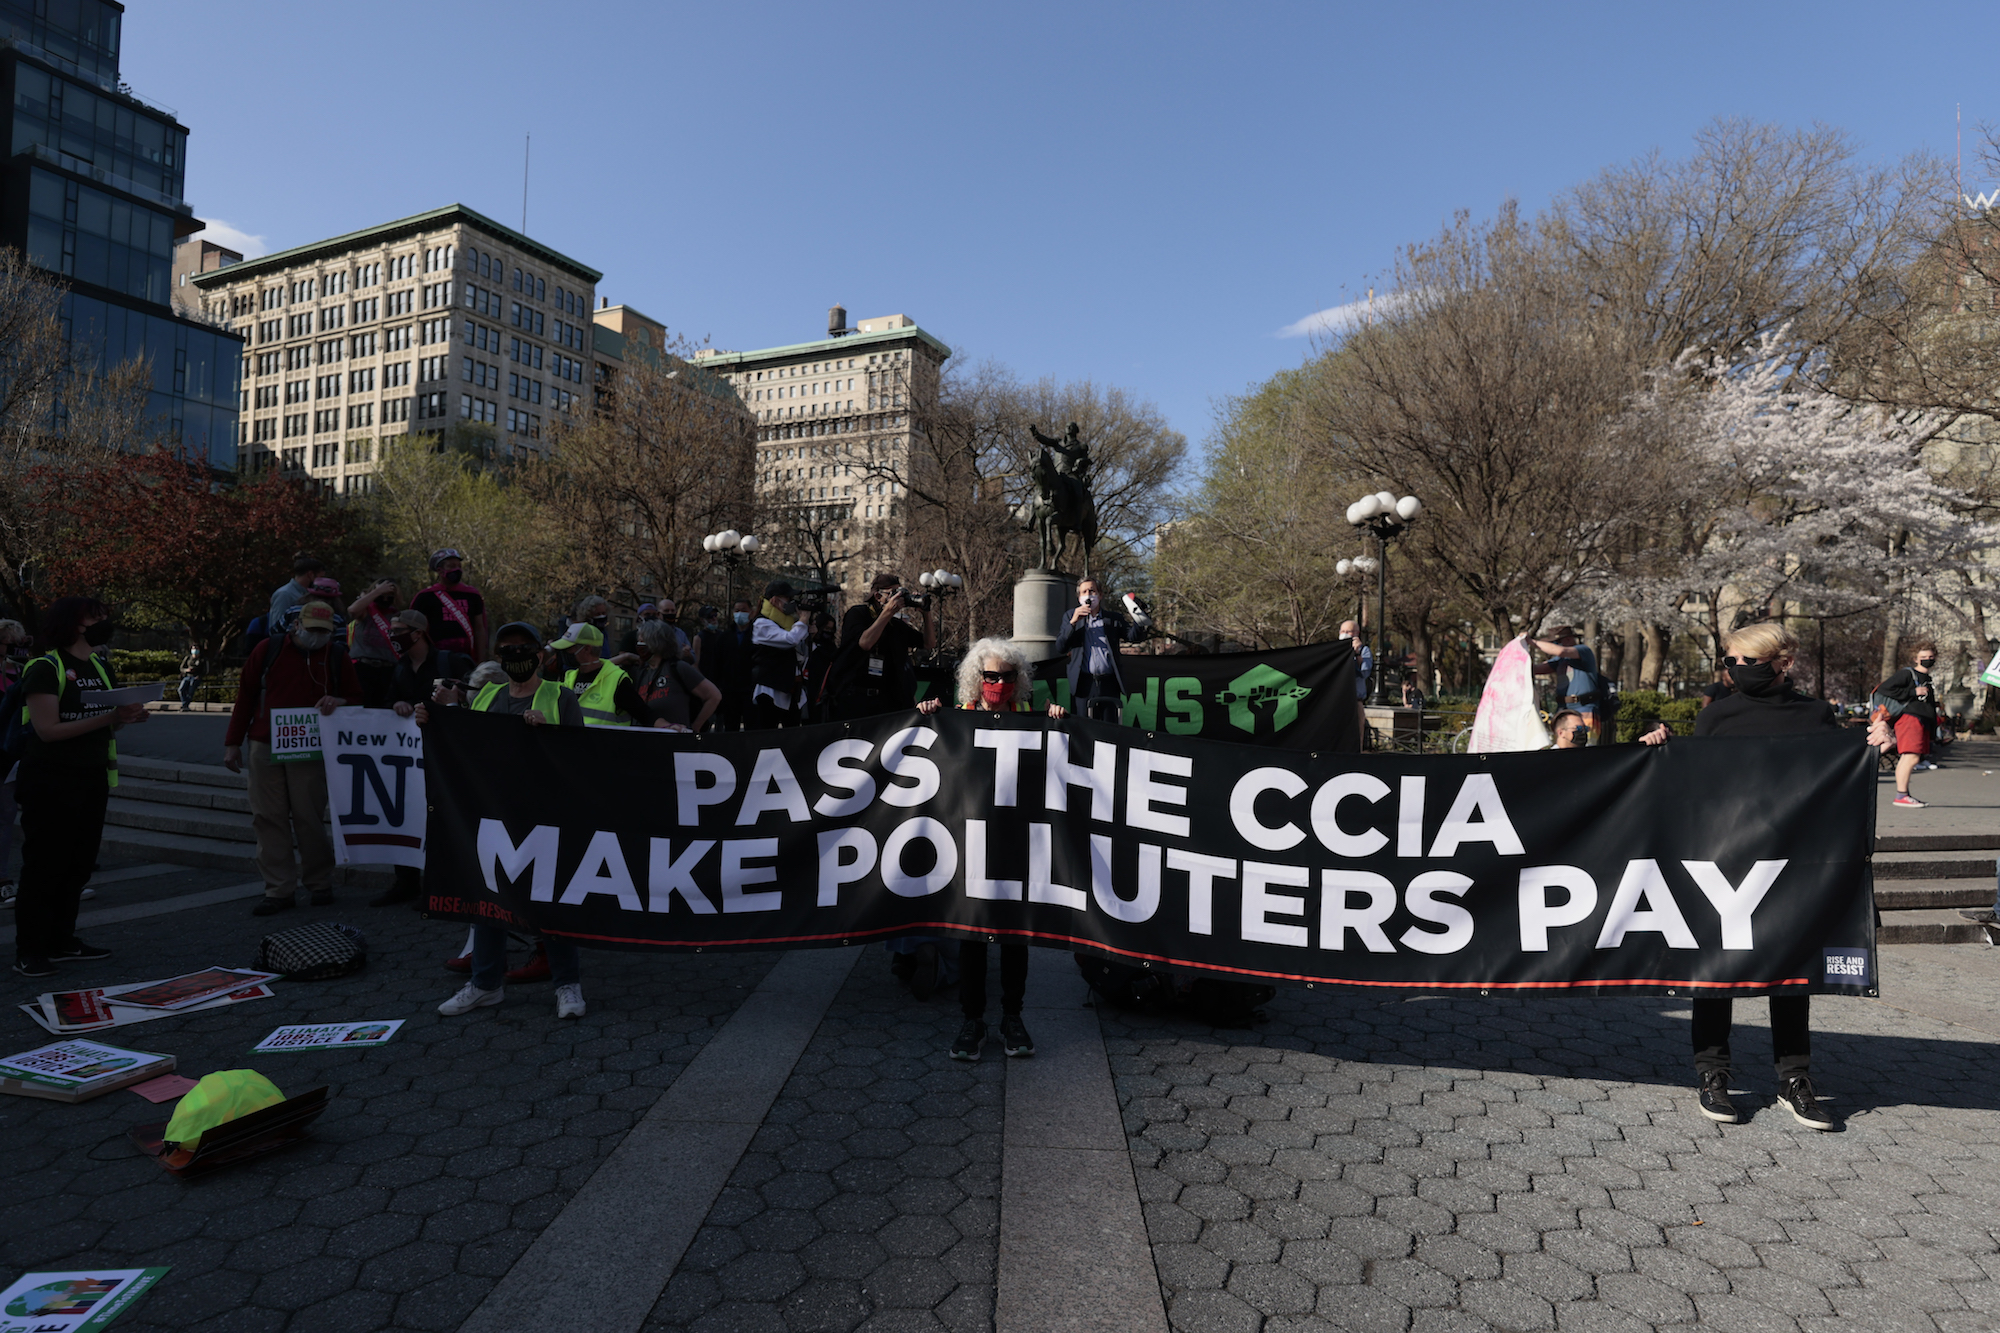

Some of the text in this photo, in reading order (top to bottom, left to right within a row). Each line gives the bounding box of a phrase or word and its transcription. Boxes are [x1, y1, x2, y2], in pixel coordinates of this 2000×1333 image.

[372, 613, 389, 630] VOTE
[276, 713, 319, 726] CLIMAT
[276, 726, 306, 737] JOBS
[276, 737, 321, 749] JUSTIC
[338, 731, 421, 748] New Yor
[337, 754, 425, 827] N
[674, 725, 1526, 857] PASS THE CCIA
[477, 816, 1789, 955] MAKE POLLUTERS PAY
[1826, 955, 1864, 965] RISE AND
[1826, 964, 1864, 976] RESIST
[262, 1037, 336, 1047] JUSTICE
